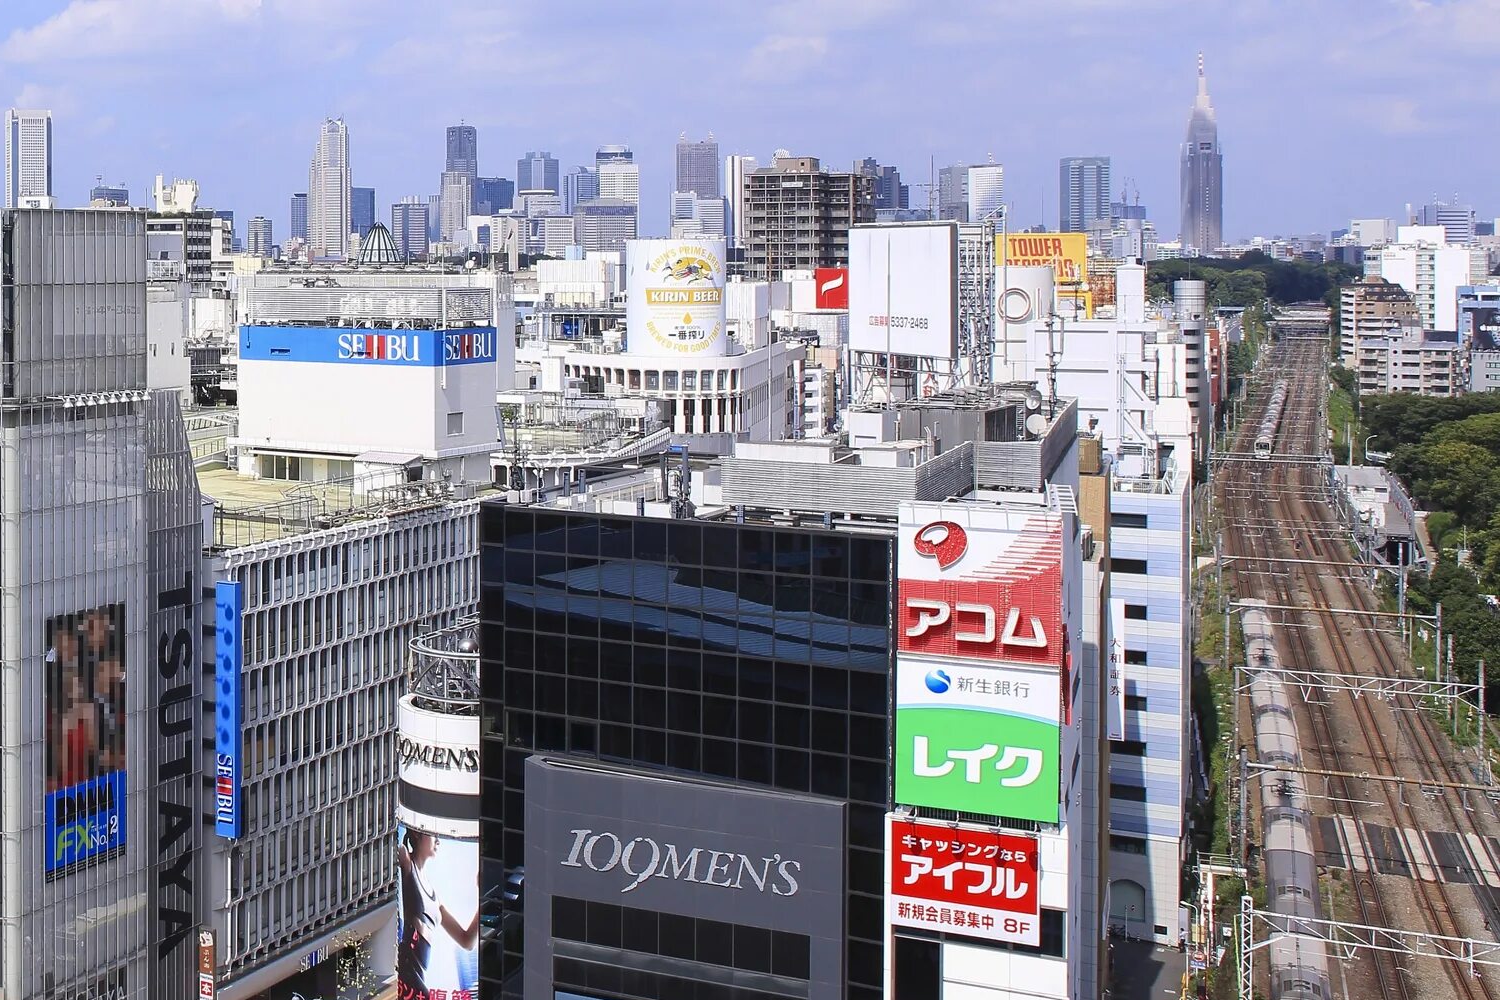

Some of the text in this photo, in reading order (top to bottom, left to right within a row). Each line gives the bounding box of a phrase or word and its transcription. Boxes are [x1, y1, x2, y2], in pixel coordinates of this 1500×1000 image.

[1009, 238, 1063, 257] TOWER
[651, 290, 719, 302] KIRIN BEER
[338, 332, 421, 362] SEIBU
[445, 332, 492, 361] SEIBU
[906, 597, 1048, 648] アコム
[1110, 637, 1121, 697] 大和証券
[957, 677, 1030, 698] 新生銀行
[157, 572, 192, 958] TSUTAYA
[913, 735, 1044, 787] レイク
[56, 782, 114, 826] DMM
[217, 753, 233, 825] SEIBU
[901, 834, 1027, 863] キャッシングなら
[900, 854, 1028, 900] アイフル
[898, 902, 1031, 935] 新規会員募集中 8F
[201, 983, 212, 995] 本
